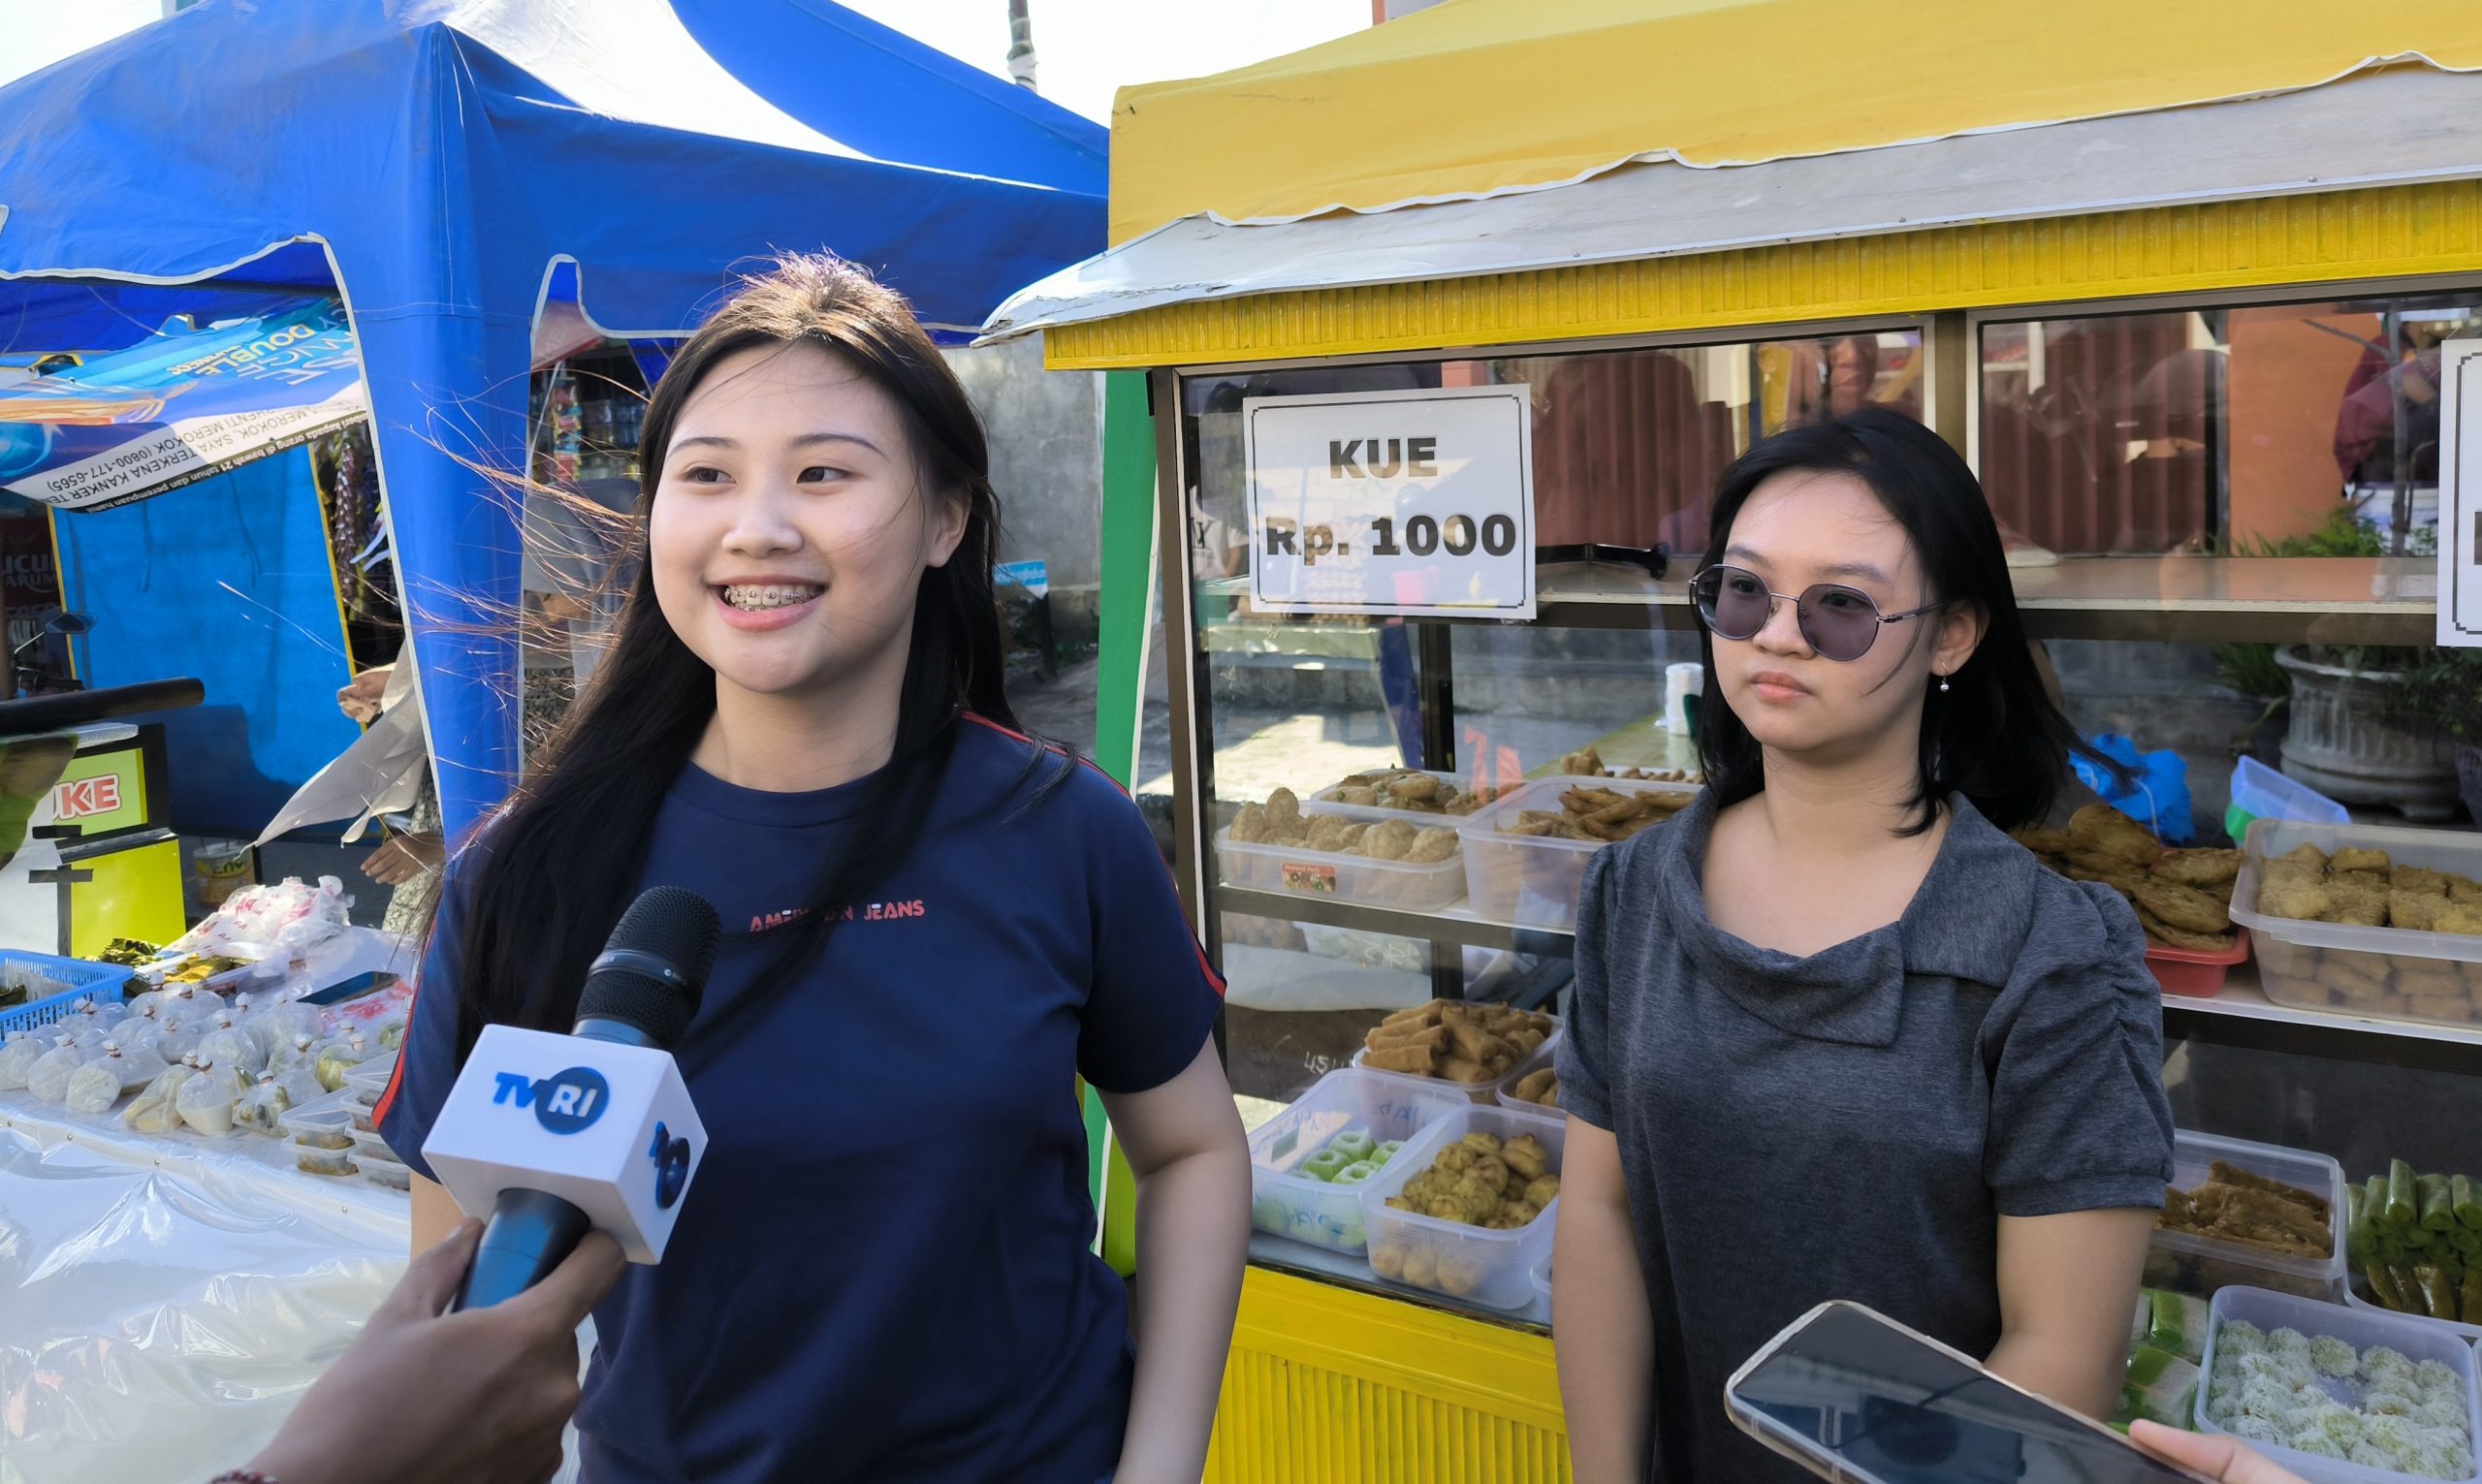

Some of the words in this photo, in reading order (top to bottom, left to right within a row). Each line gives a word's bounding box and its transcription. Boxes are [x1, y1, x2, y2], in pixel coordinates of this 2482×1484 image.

[195, 323, 316, 376] DOUBLE
[153, 422, 225, 454] MEROKOK
[199, 435, 234, 453] SAYA
[276, 435, 305, 451] orang
[234, 449, 267, 467] bawah
[267, 445, 276, 457] di
[1329, 437, 1438, 479] KUE
[130, 448, 199, 479] TERKENA
[220, 462, 234, 473] 21
[72, 474, 130, 500] KANKER
[171, 477, 191, 489] dan
[1265, 517, 1350, 567] Rp.
[1371, 514, 1516, 557] 1000
[864, 900, 925, 921] JEANS
[493, 1070, 600, 1119] TVRI
